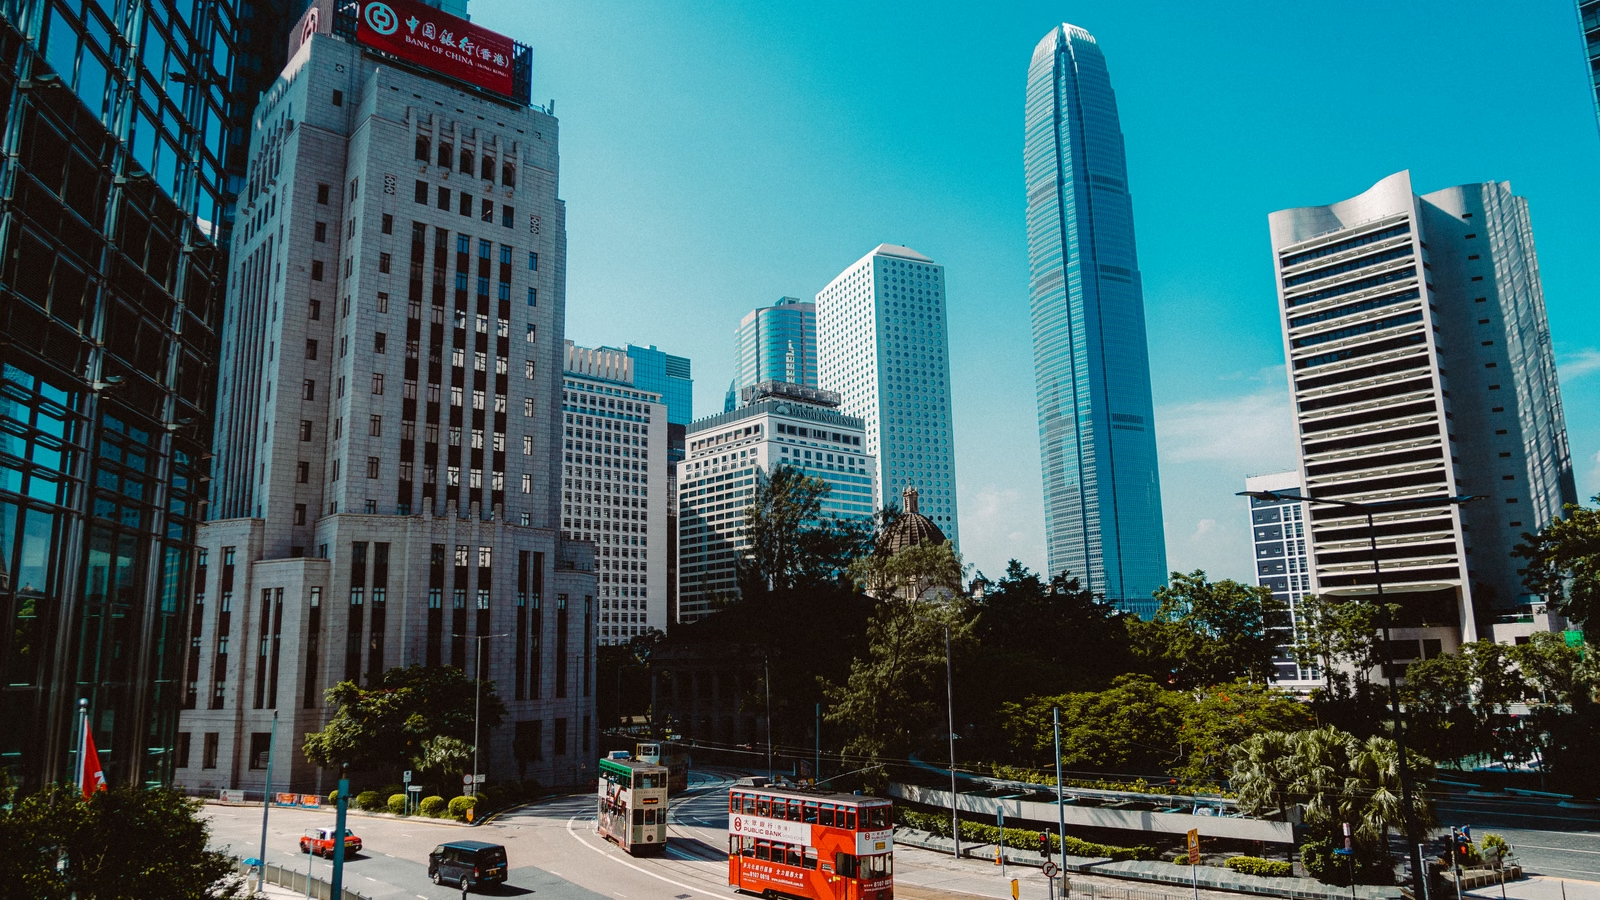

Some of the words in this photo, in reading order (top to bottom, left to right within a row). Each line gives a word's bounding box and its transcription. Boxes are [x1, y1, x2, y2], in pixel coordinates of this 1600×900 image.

[406, 35, 430, 50] BANK
[432, 46, 444, 54] OF
[445, 51, 473, 66] CHINA
[790, 408, 828, 422] MANDARIN
[828, 415, 861, 428] ORIENTAL
